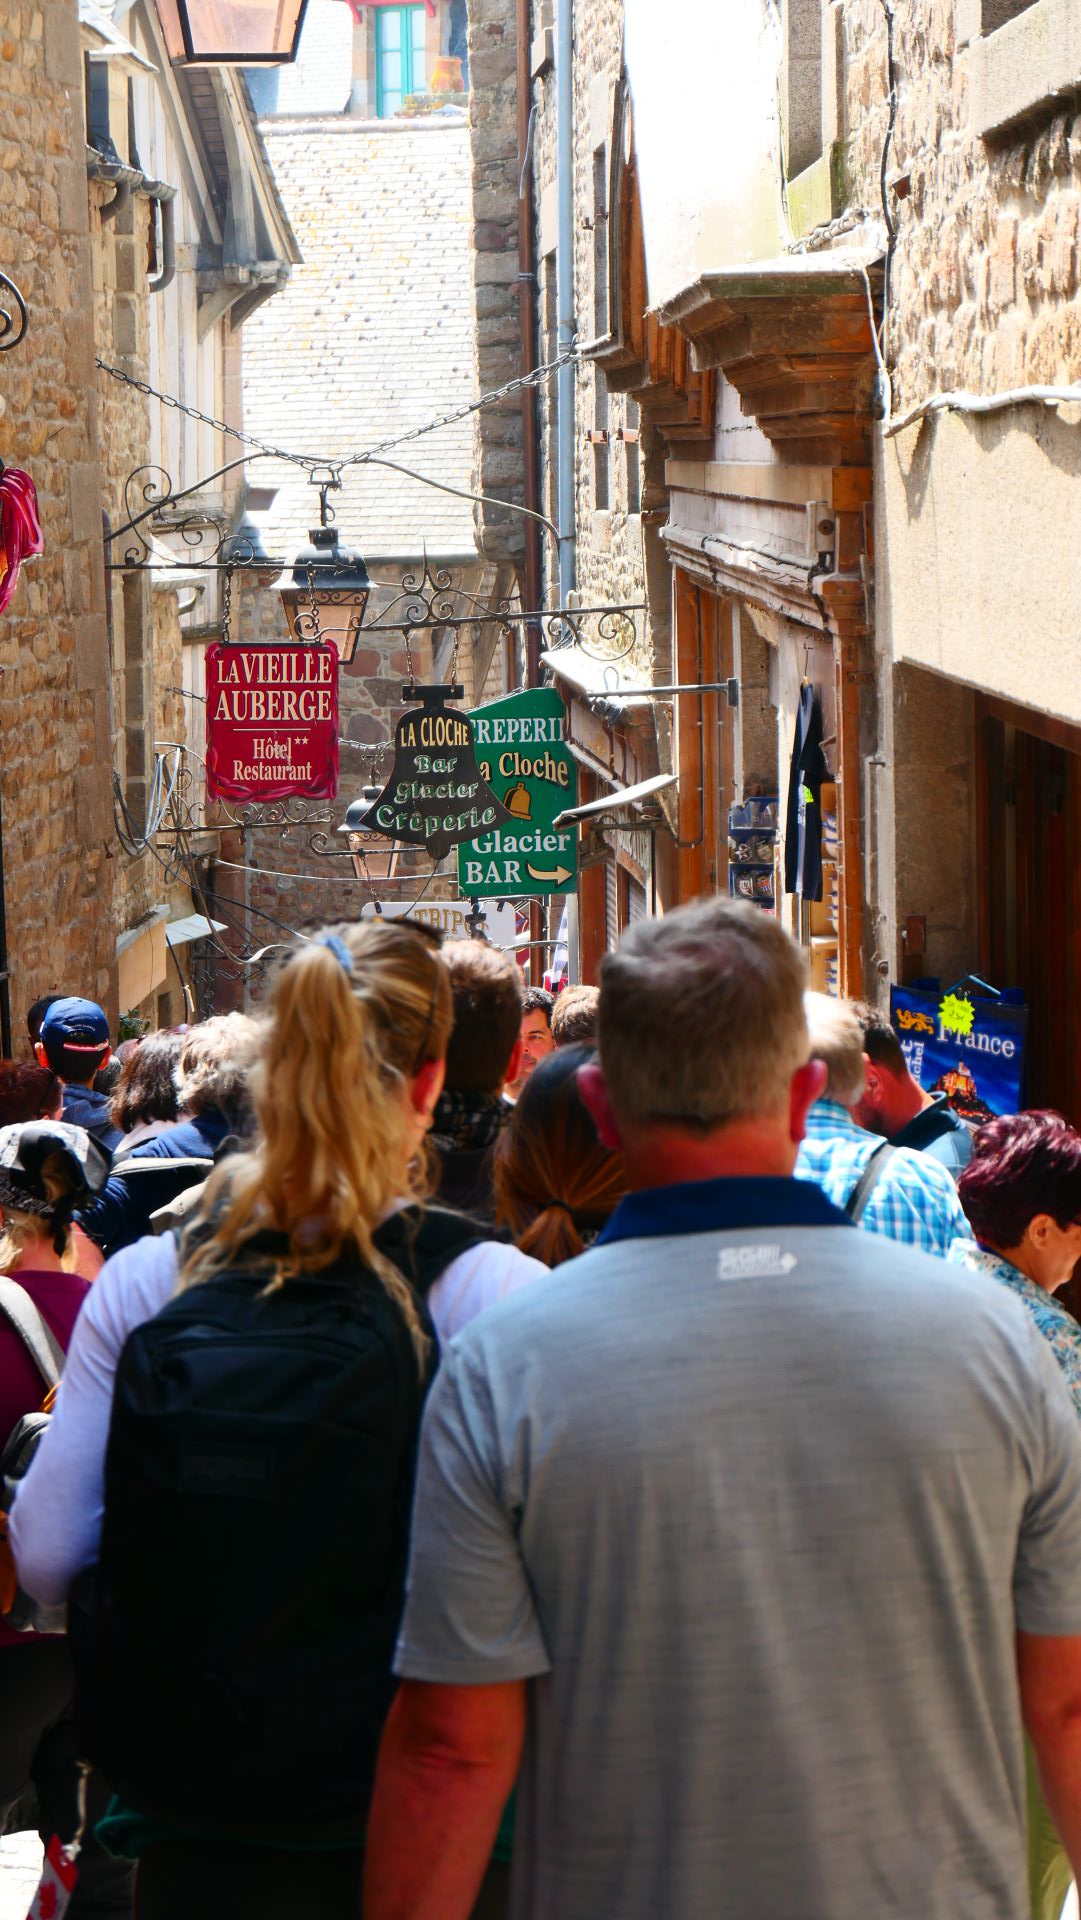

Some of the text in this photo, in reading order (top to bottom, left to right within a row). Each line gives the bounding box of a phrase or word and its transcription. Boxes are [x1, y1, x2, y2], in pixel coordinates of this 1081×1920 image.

[217, 653, 332, 684] LA VIEILLE
[213, 690, 332, 721] AUBERGE
[401, 717, 469, 748] LA CLOCHE
[253, 737, 292, 760] Hôtel
[233, 760, 312, 781] Restaurant
[413, 754, 458, 774] Bar
[499, 751, 569, 786] Cloche
[393, 780, 479, 805] Glacier
[376, 804, 497, 838] Crêperie
[472, 828, 571, 854] Glacier
[465, 860, 522, 884] BAR
